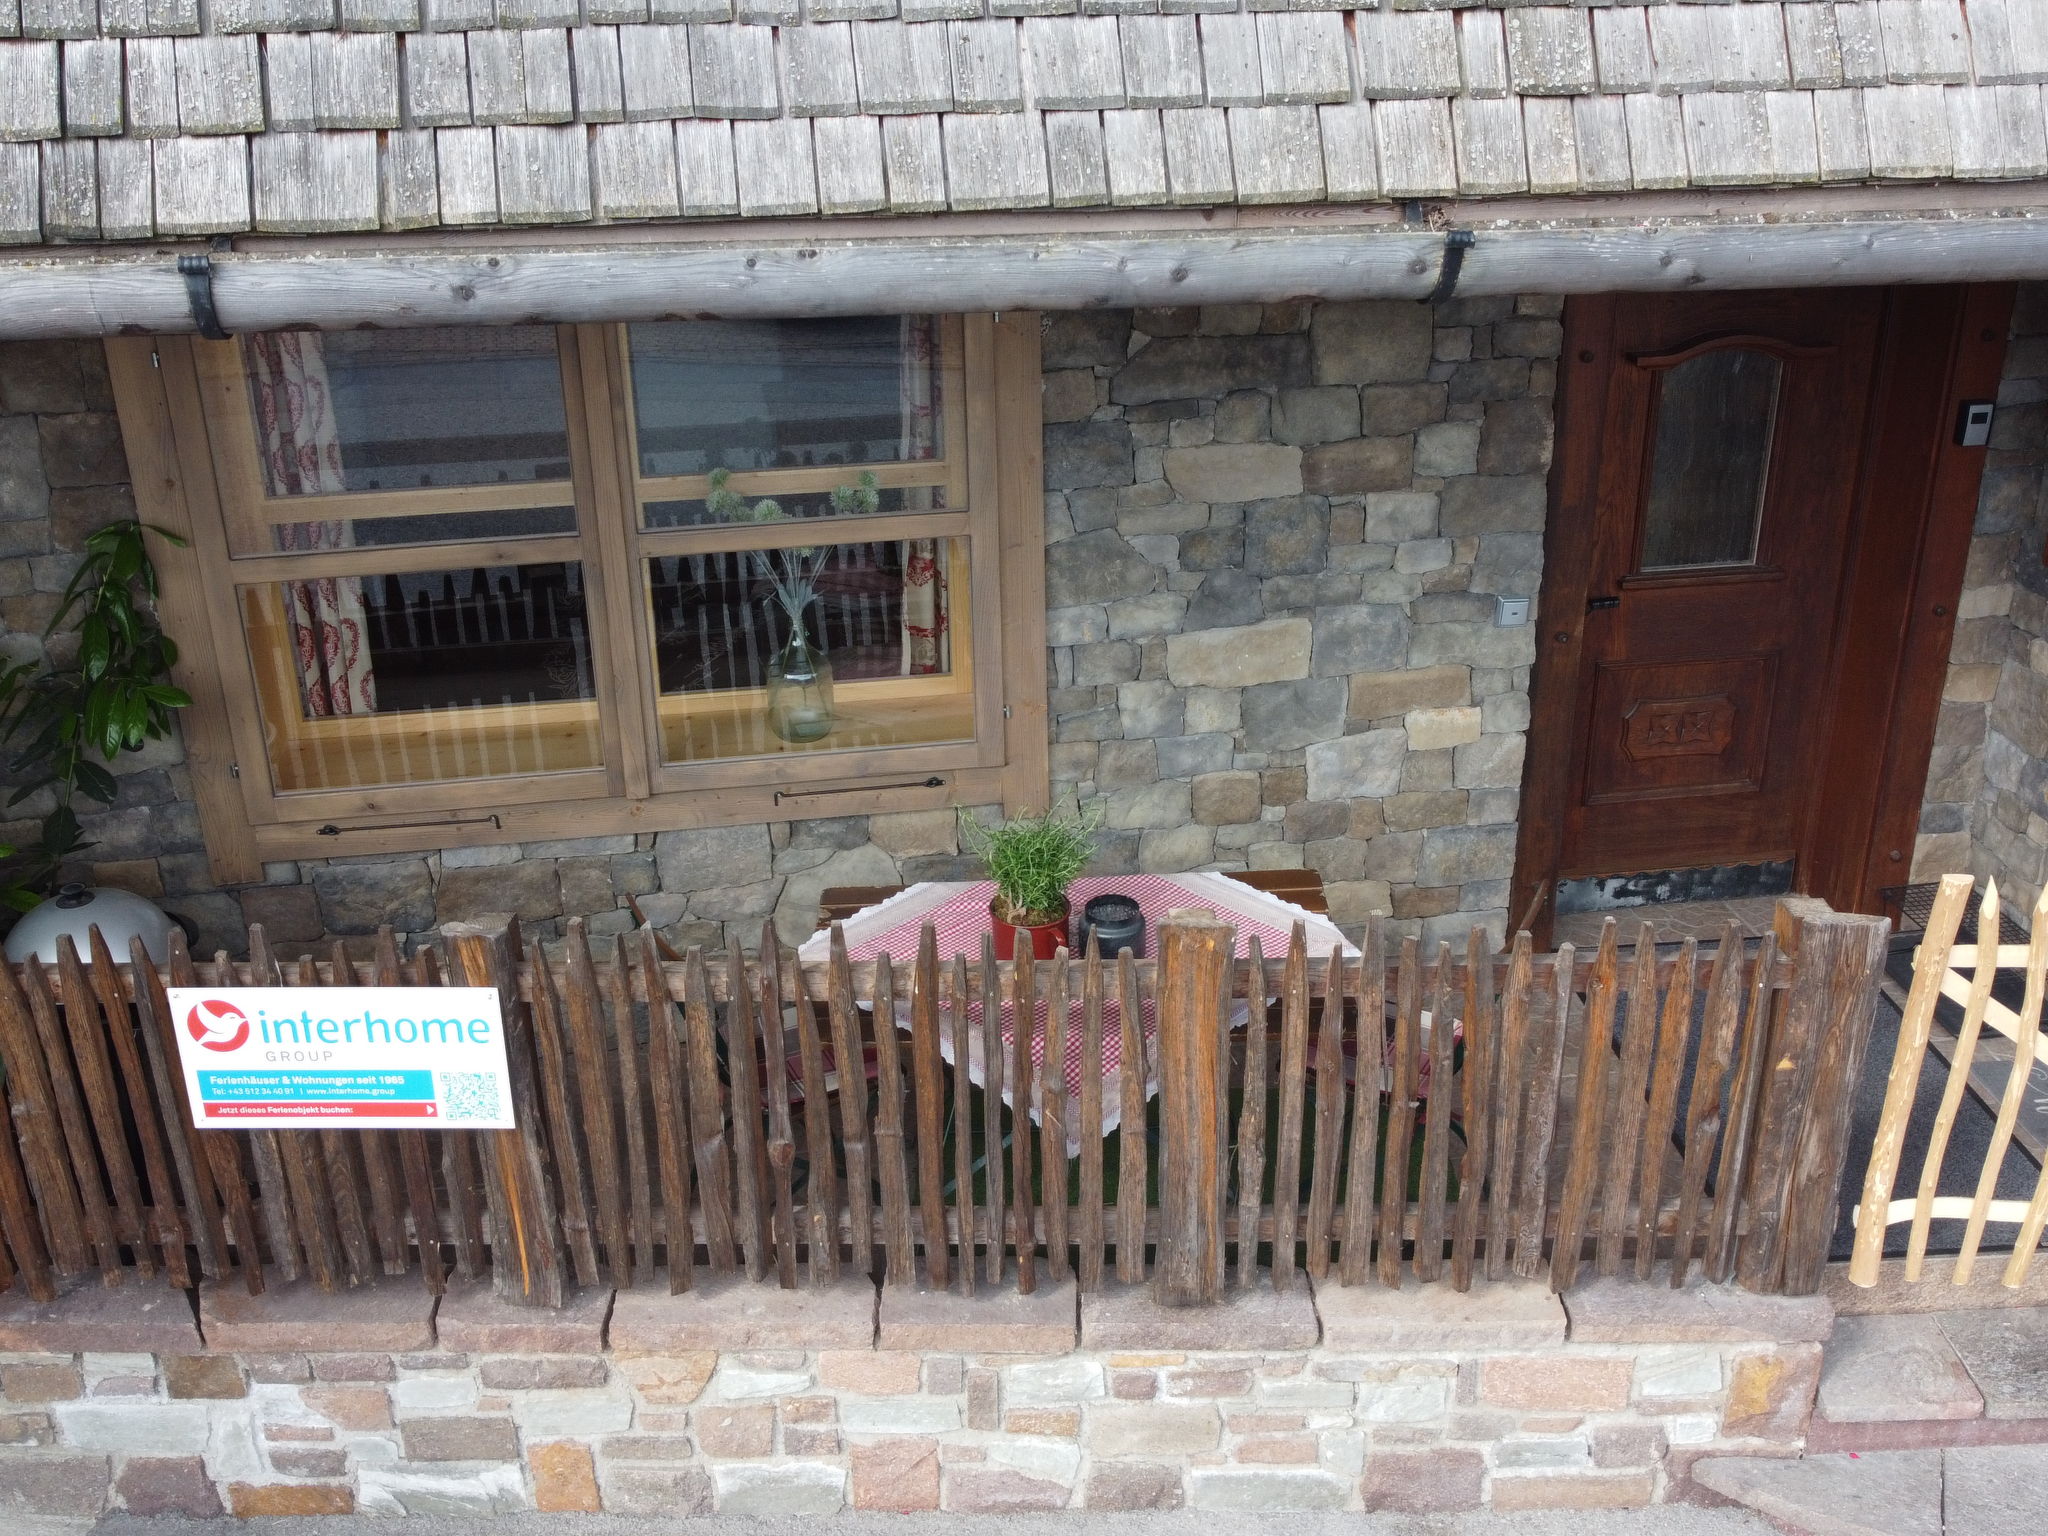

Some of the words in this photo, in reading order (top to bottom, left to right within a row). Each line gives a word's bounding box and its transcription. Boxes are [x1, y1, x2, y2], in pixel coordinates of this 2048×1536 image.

[258, 1010, 490, 1044] interhome
[265, 1051, 333, 1062] GROUP
[210, 1076, 279, 1085] Ferienhäuser
[282, 1076, 290, 1085] &
[292, 1076, 354, 1087] Wohnungen
[356, 1076, 377, 1085] seit
[306, 1088, 396, 1096] www.interhome.group
[267, 1107, 318, 1115] Ferienobjekt
